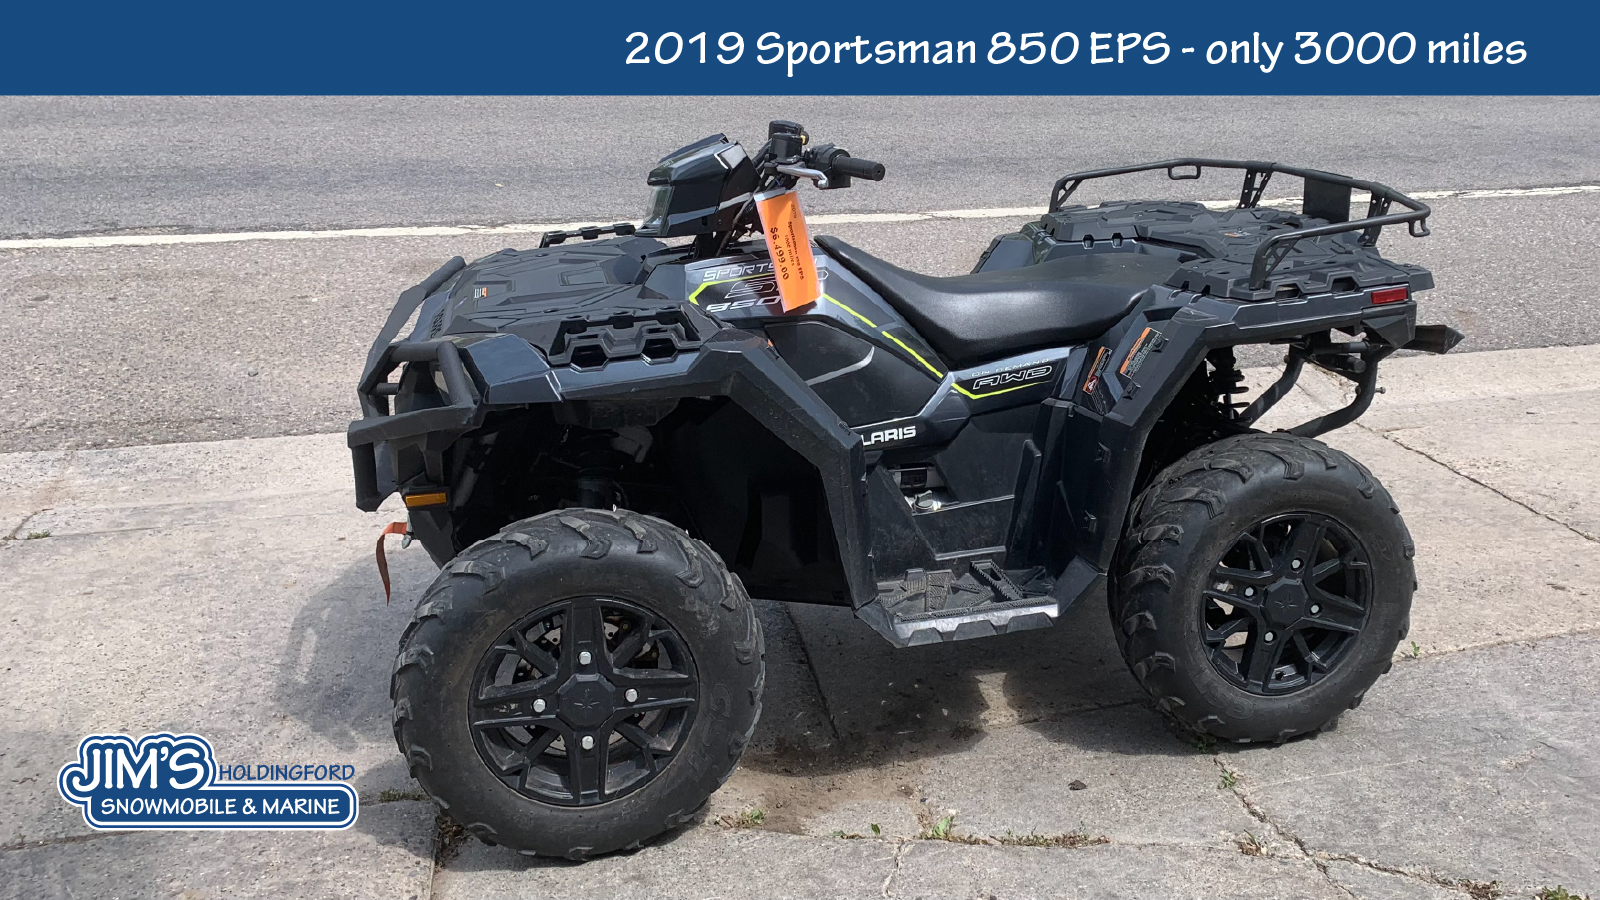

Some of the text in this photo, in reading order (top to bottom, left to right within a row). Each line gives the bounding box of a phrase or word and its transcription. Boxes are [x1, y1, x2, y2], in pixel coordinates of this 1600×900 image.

[703, 262, 776, 282] SPORTS
[972, 365, 1053, 390] AWD
[860, 425, 917, 446] LARIS
